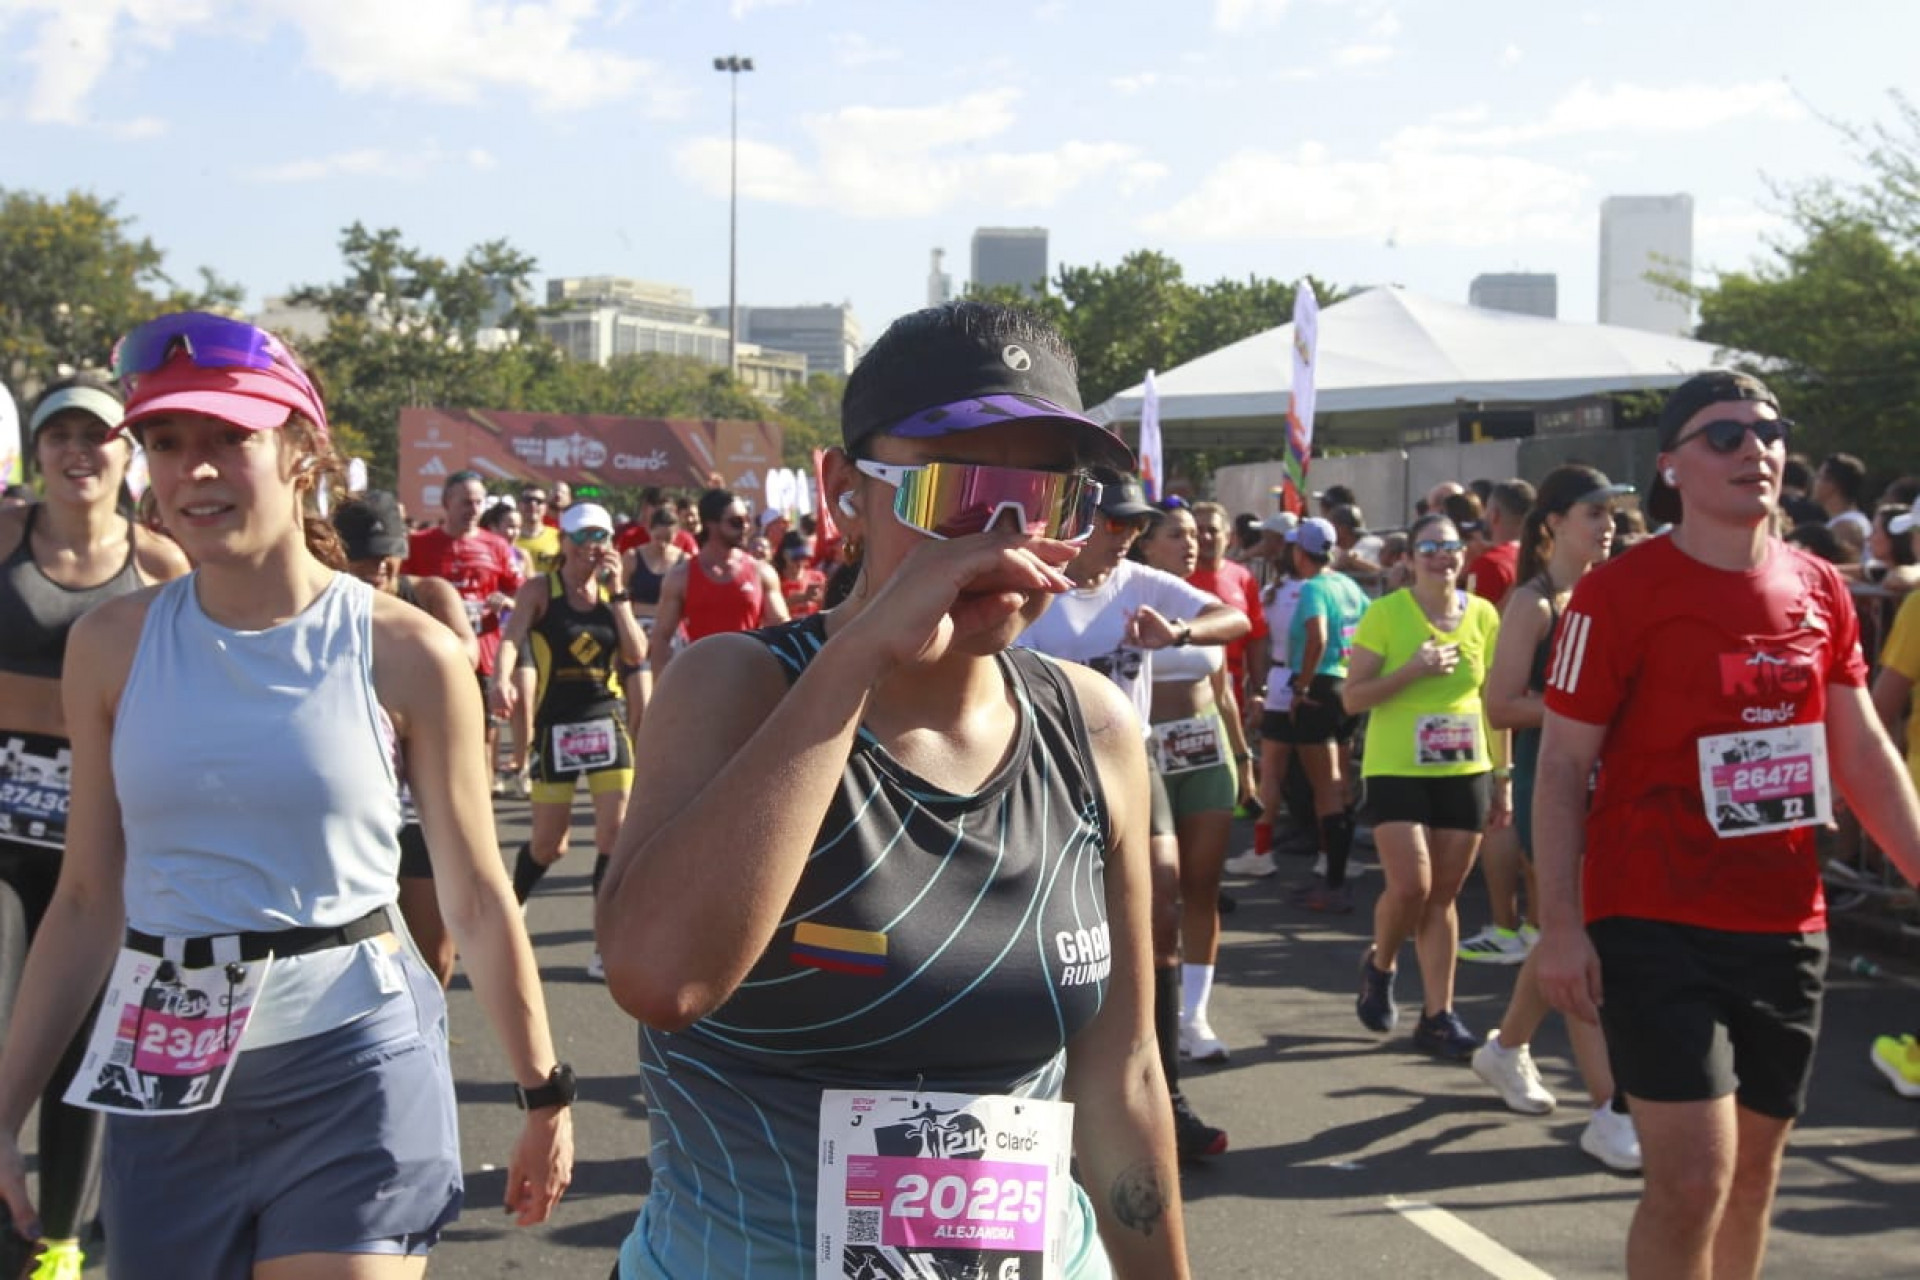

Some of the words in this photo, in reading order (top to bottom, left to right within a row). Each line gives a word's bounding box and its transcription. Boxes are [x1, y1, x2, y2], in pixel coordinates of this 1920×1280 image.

[1742, 703, 1795, 723] Claro
[1733, 762, 1809, 790] 26472
[996, 1130, 1039, 1151] Claro
[890, 1173, 1045, 1224] 20225
[934, 1224, 1015, 1242] ALEJANDRA
